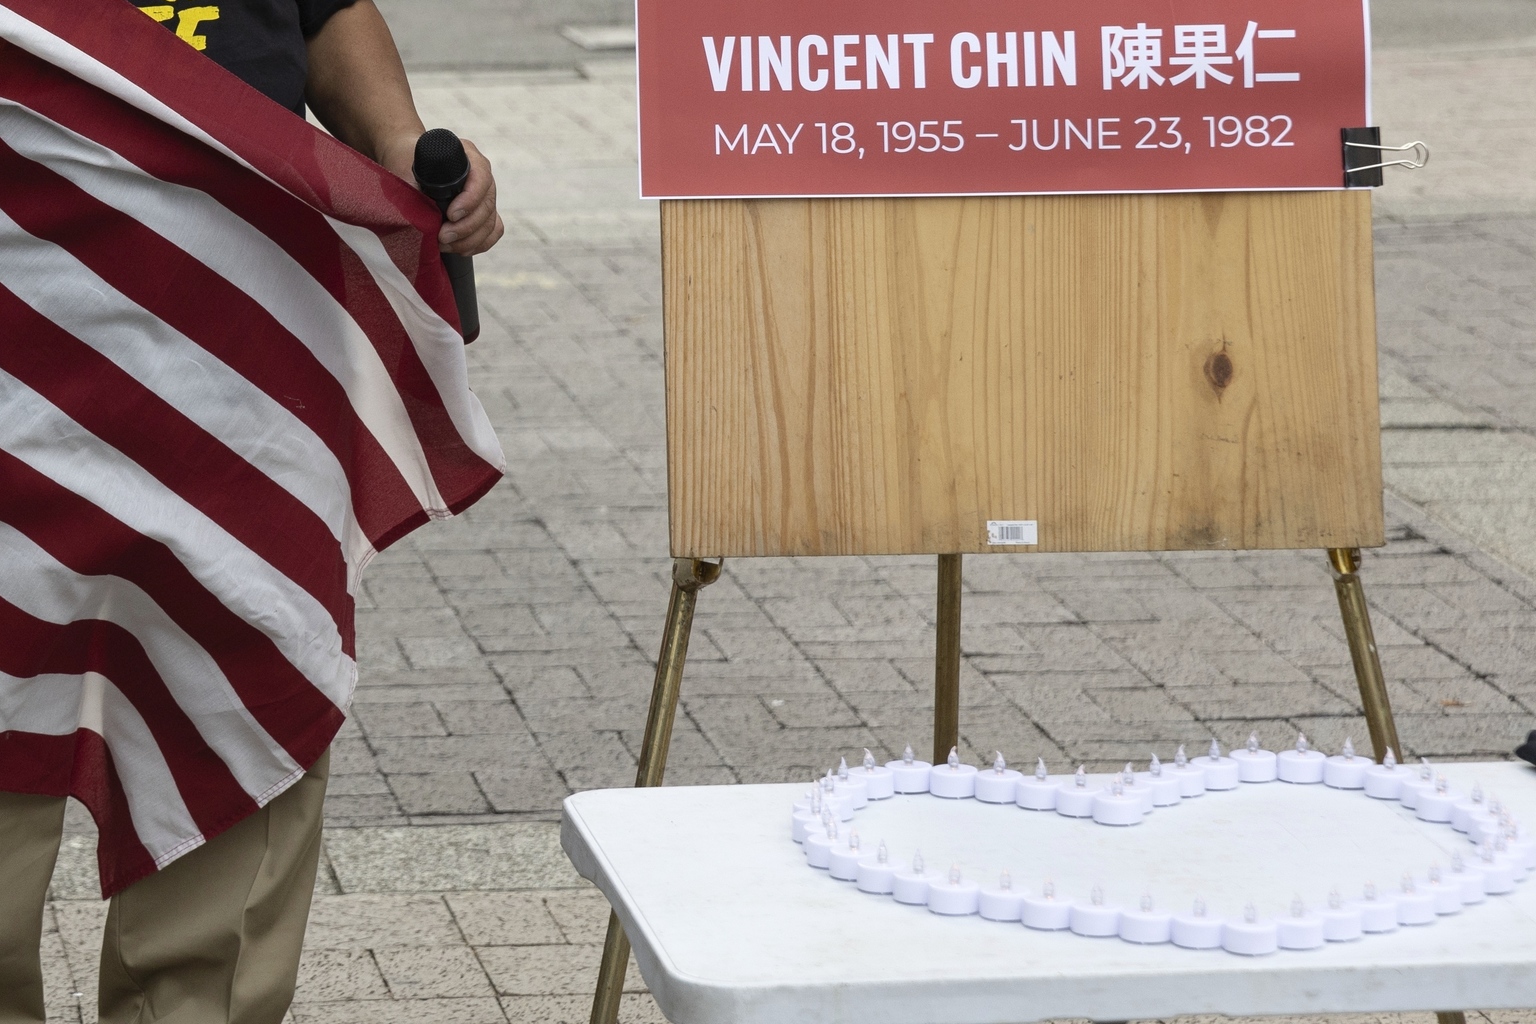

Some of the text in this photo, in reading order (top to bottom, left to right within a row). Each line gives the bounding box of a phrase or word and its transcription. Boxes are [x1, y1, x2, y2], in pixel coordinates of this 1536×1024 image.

[702, 20, 1300, 92] VINCENT CHIN 陳果仁
[715, 123, 804, 155] MAY
[814, 122, 865, 160] 18,
[876, 120, 964, 153] 1955
[1008, 118, 1121, 151] JUNE
[1134, 117, 1191, 154] 23,
[1202, 115, 1295, 148] 1982
